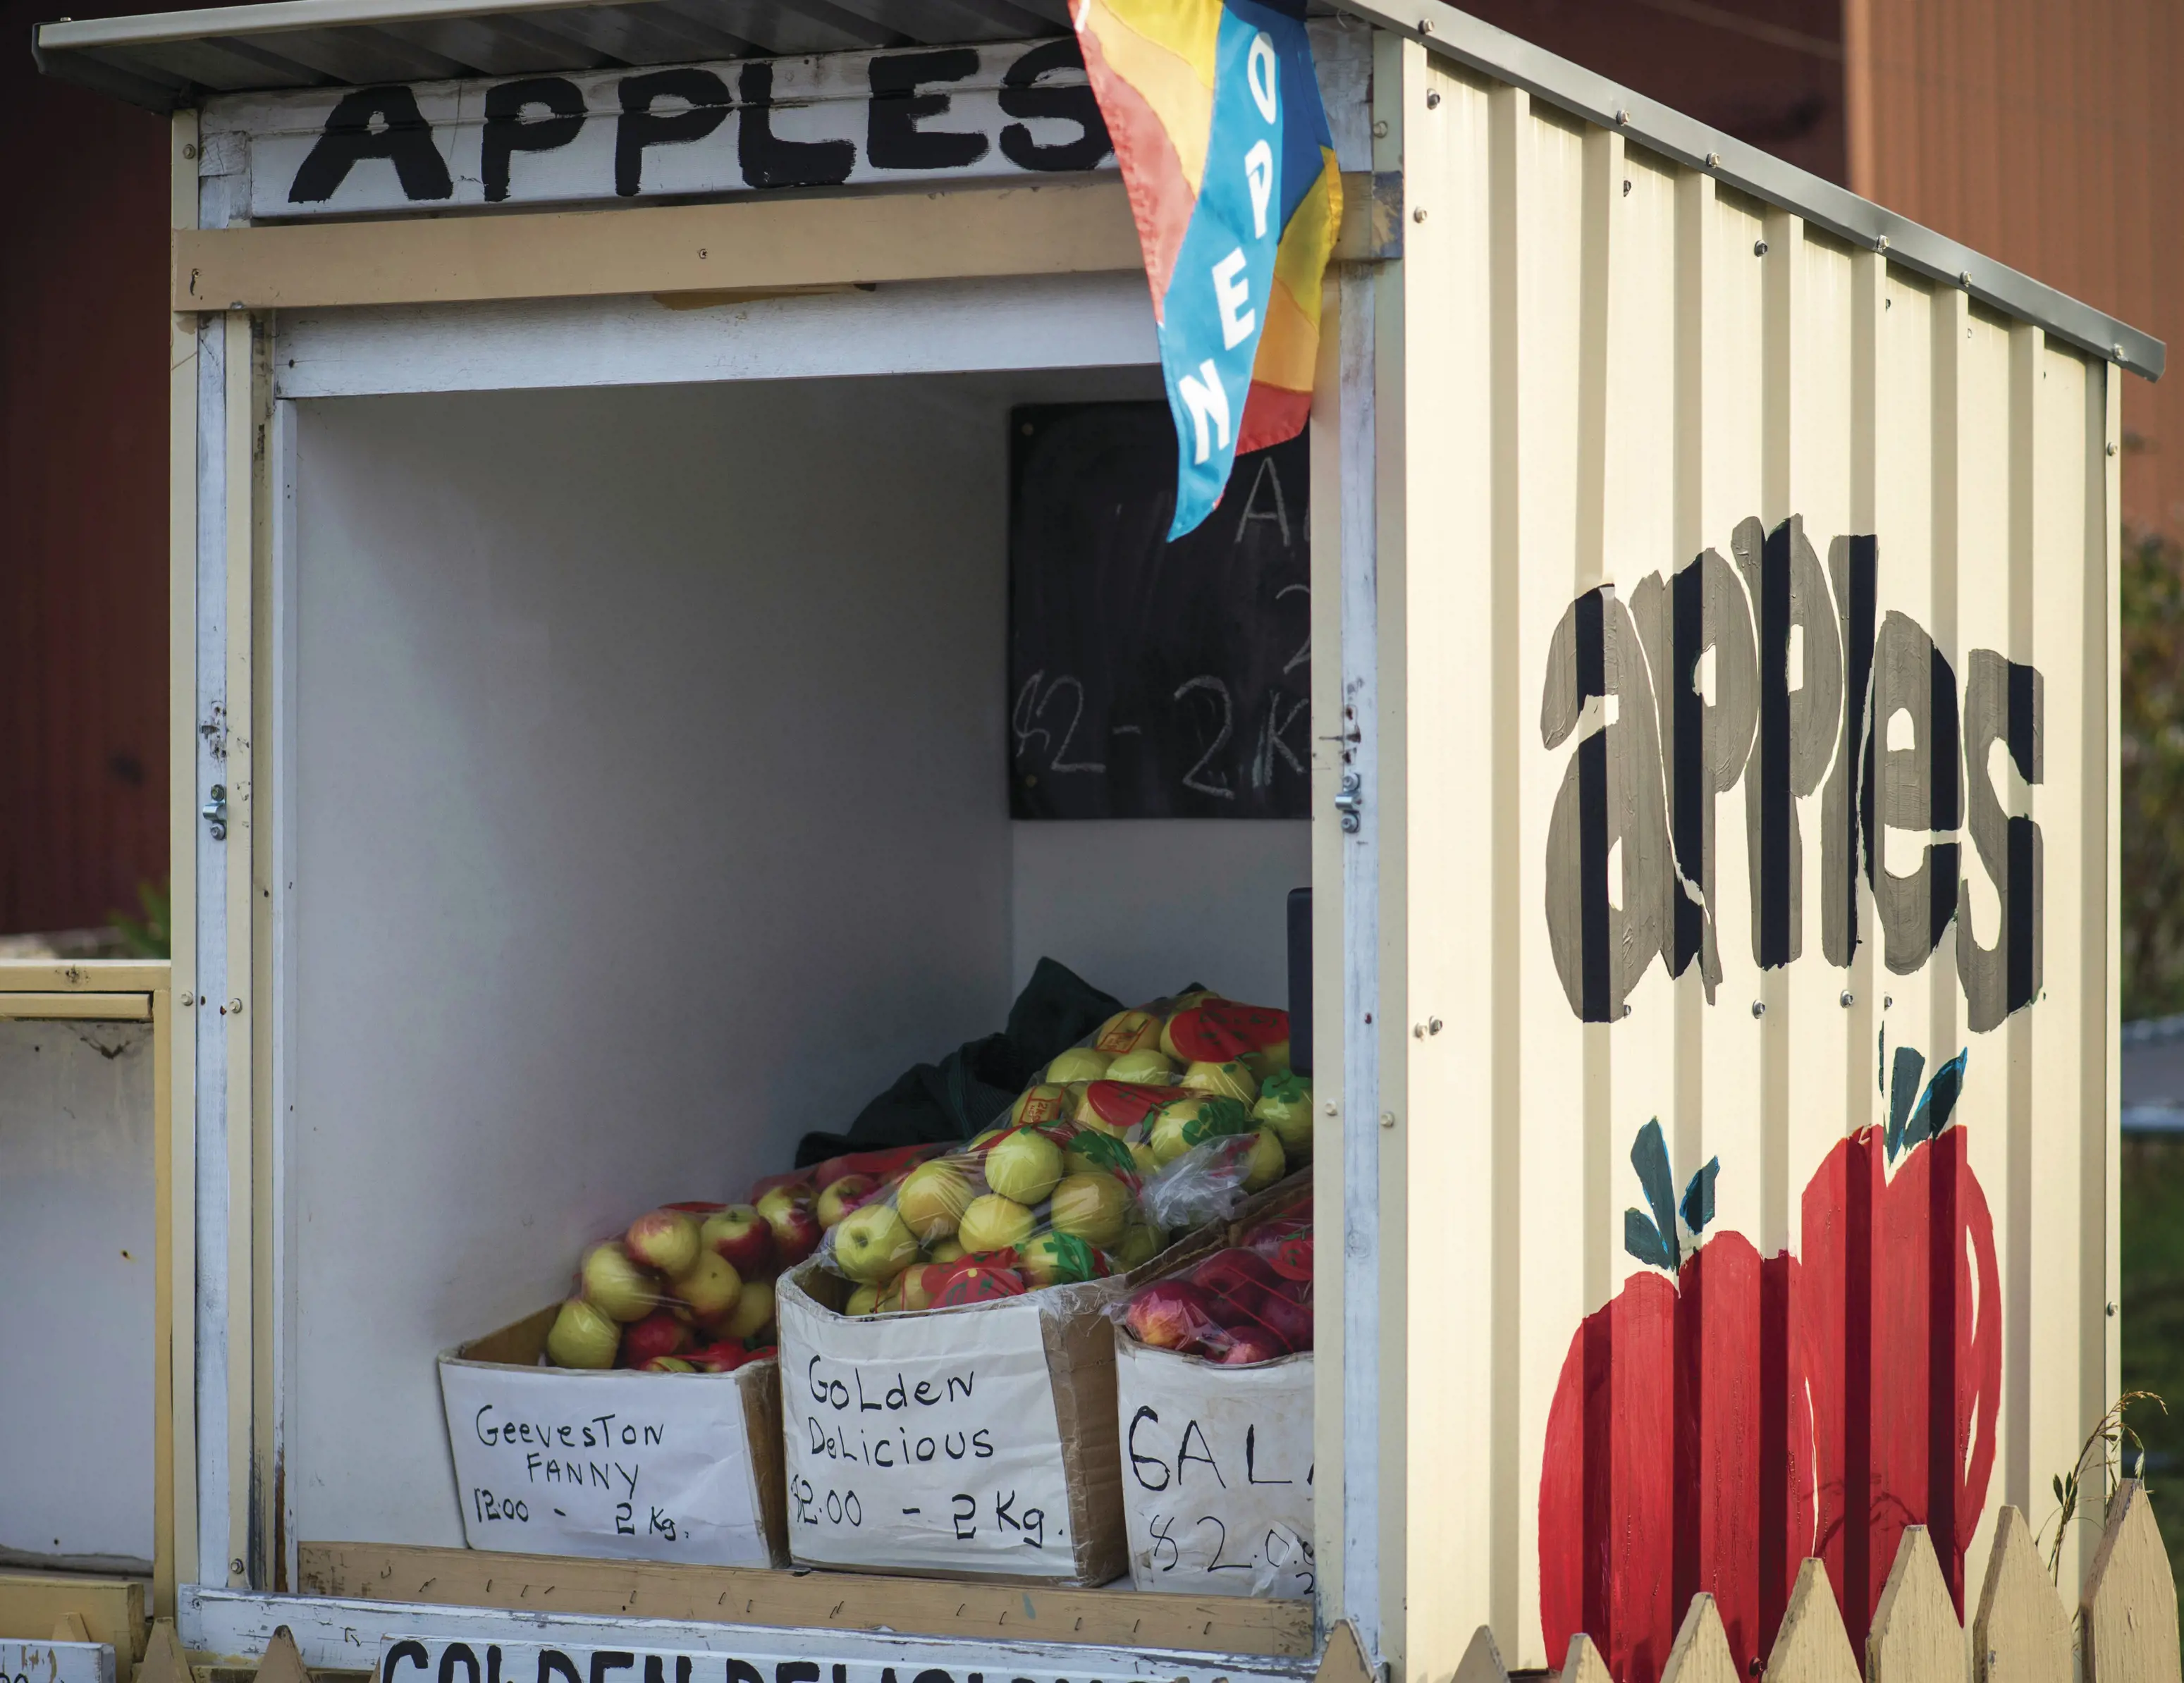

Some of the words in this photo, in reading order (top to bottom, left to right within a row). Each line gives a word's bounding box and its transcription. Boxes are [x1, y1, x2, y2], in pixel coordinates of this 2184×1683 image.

[288, 37, 1115, 203] APPLES
[1179, 32, 1278, 464] OPEN
[527, 1452, 638, 1499] FANNY
[1129, 1405, 1314, 1491] GAL
[615, 1502, 635, 1534] 2
[952, 1493, 976, 1540] 2
